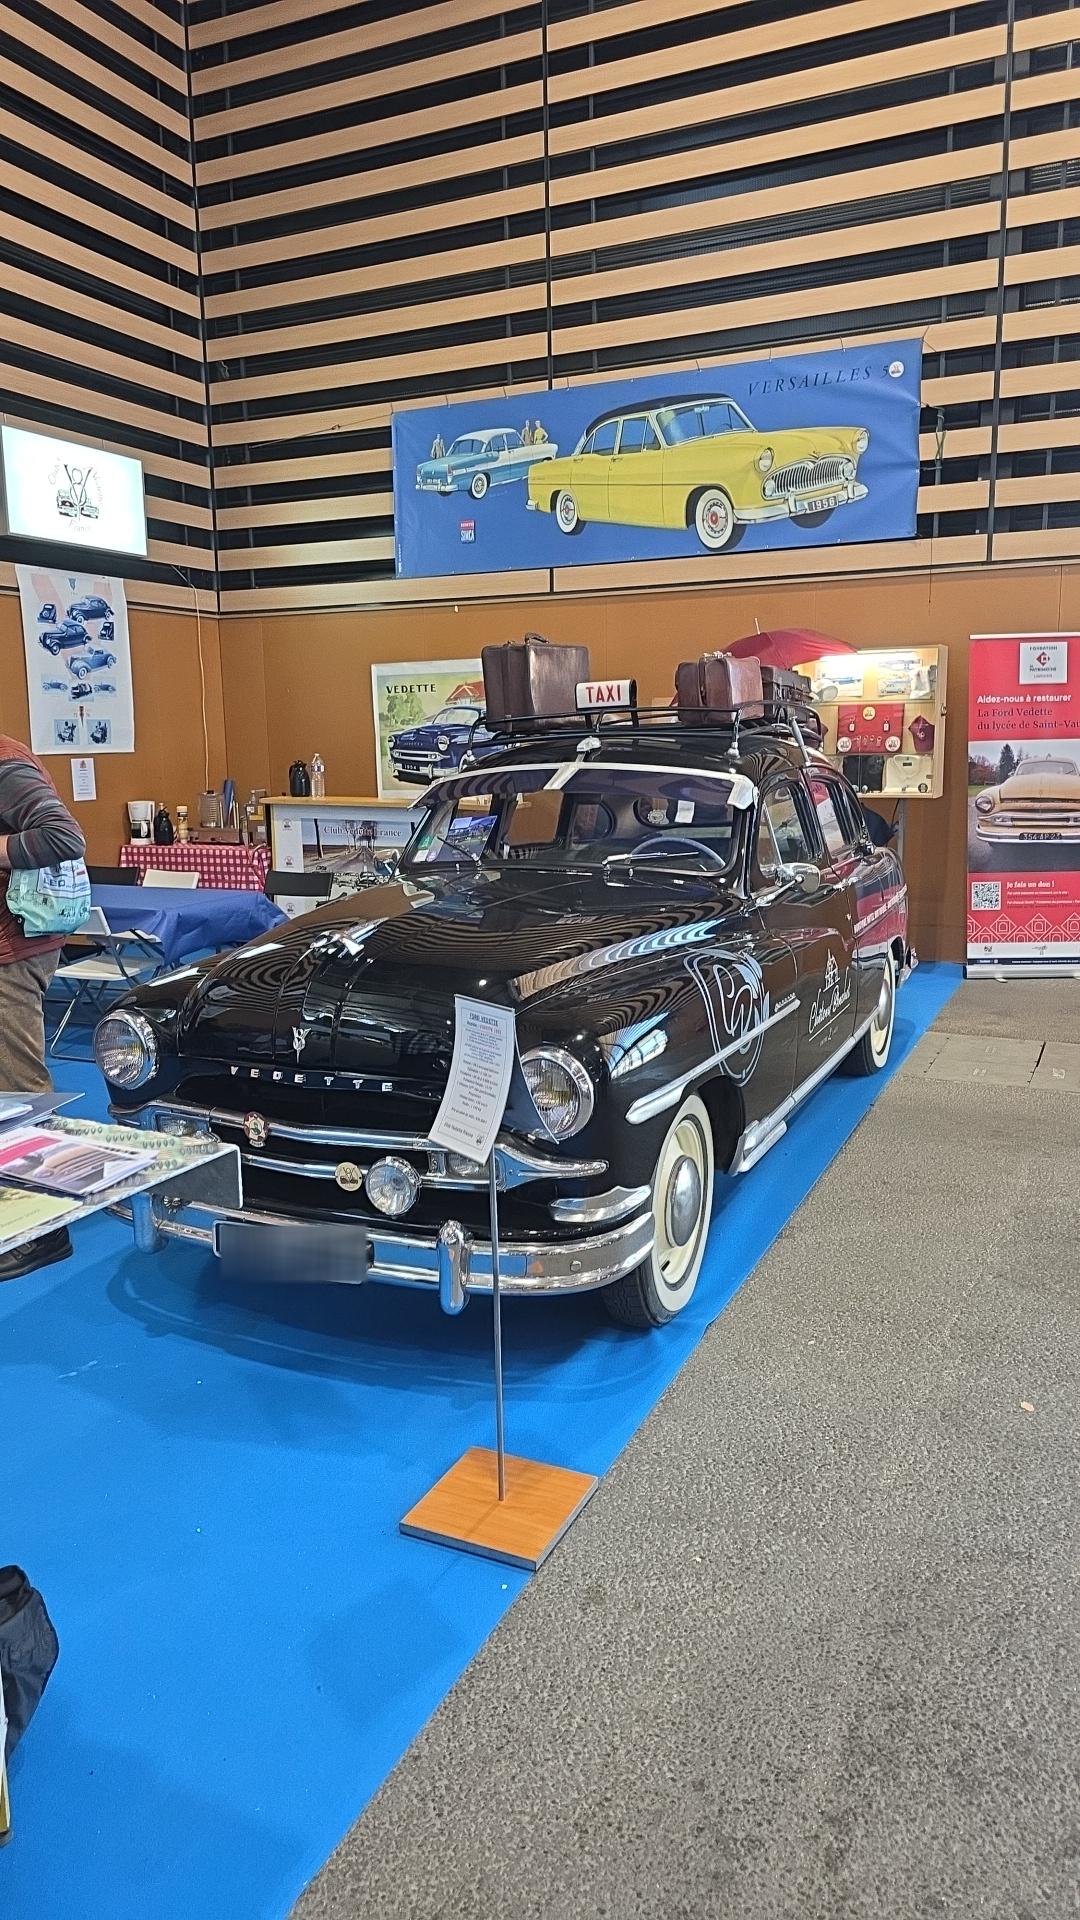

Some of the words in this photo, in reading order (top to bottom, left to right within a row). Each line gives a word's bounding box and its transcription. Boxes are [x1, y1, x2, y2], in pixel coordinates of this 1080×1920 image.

[748, 366, 872, 396] VERSAILLES
[812, 497, 835, 510] 1956
[386, 684, 437, 694] VEDETTE
[585, 684, 621, 704] TAXI
[976, 695, 1024, 704] Aidez-nous
[1026, 693, 1032, 703] à
[1033, 694, 1072, 702] restaurer
[977, 708, 990, 718] La
[992, 708, 1014, 717] Ford
[1016, 706, 1054, 716] Vedette
[977, 721, 990, 730] du
[992, 720, 1017, 732] lycée
[1019, 720, 1031, 730] de
[323, 826, 343, 835] Club
[230, 1065, 394, 1092] VEDETTE
